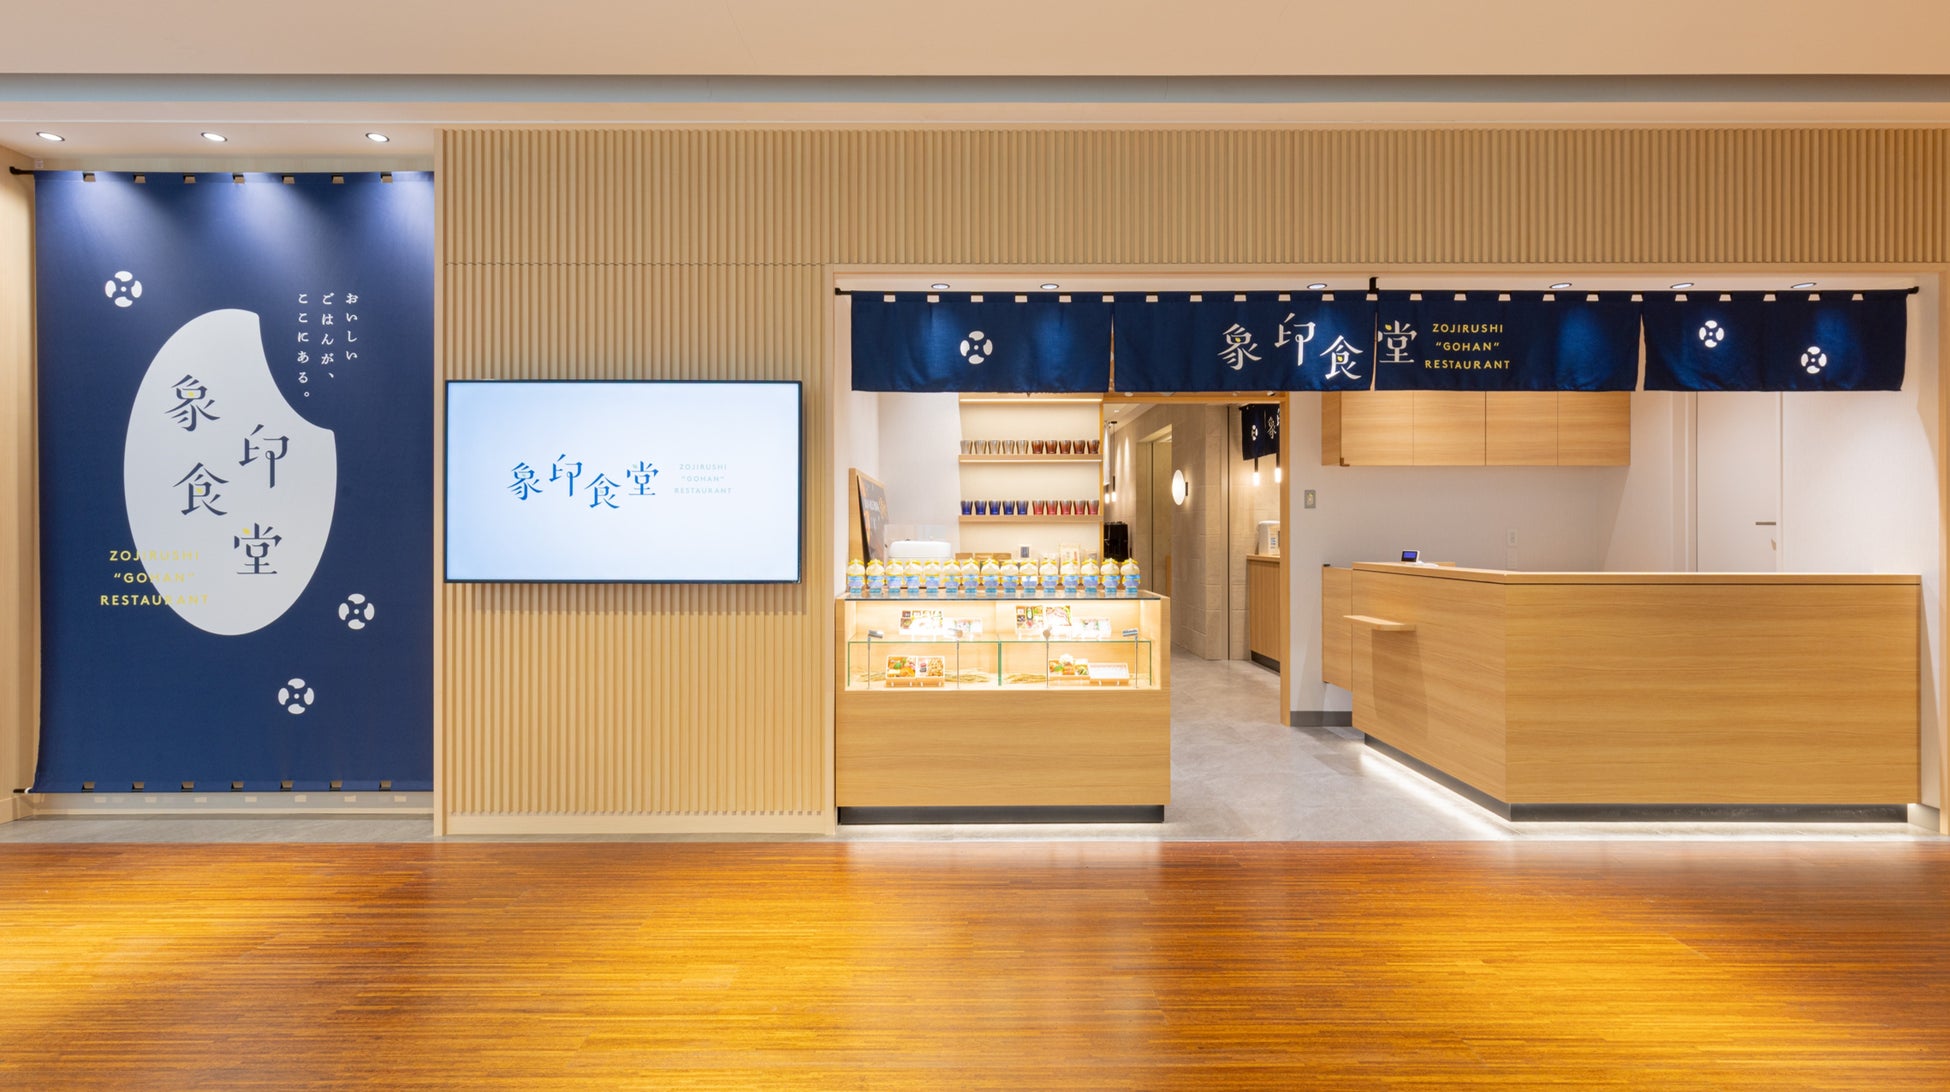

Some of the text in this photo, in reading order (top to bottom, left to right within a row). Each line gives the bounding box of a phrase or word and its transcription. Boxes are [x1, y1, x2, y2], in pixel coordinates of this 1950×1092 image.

[297, 293, 310, 398] ここにある。
[321, 292, 335, 379] ごはんが、
[345, 292, 359, 360] おいしい
[1217, 312, 1418, 380] 象印食堂
[1432, 323, 1504, 334] ZOJIRUSHI
[1424, 359, 1511, 370] RESTAURANT
[506, 453, 660, 509] 象印食堂
[109, 550, 200, 561] ZOJIRUSHI
[100, 595, 208, 606] RESTAURANT
